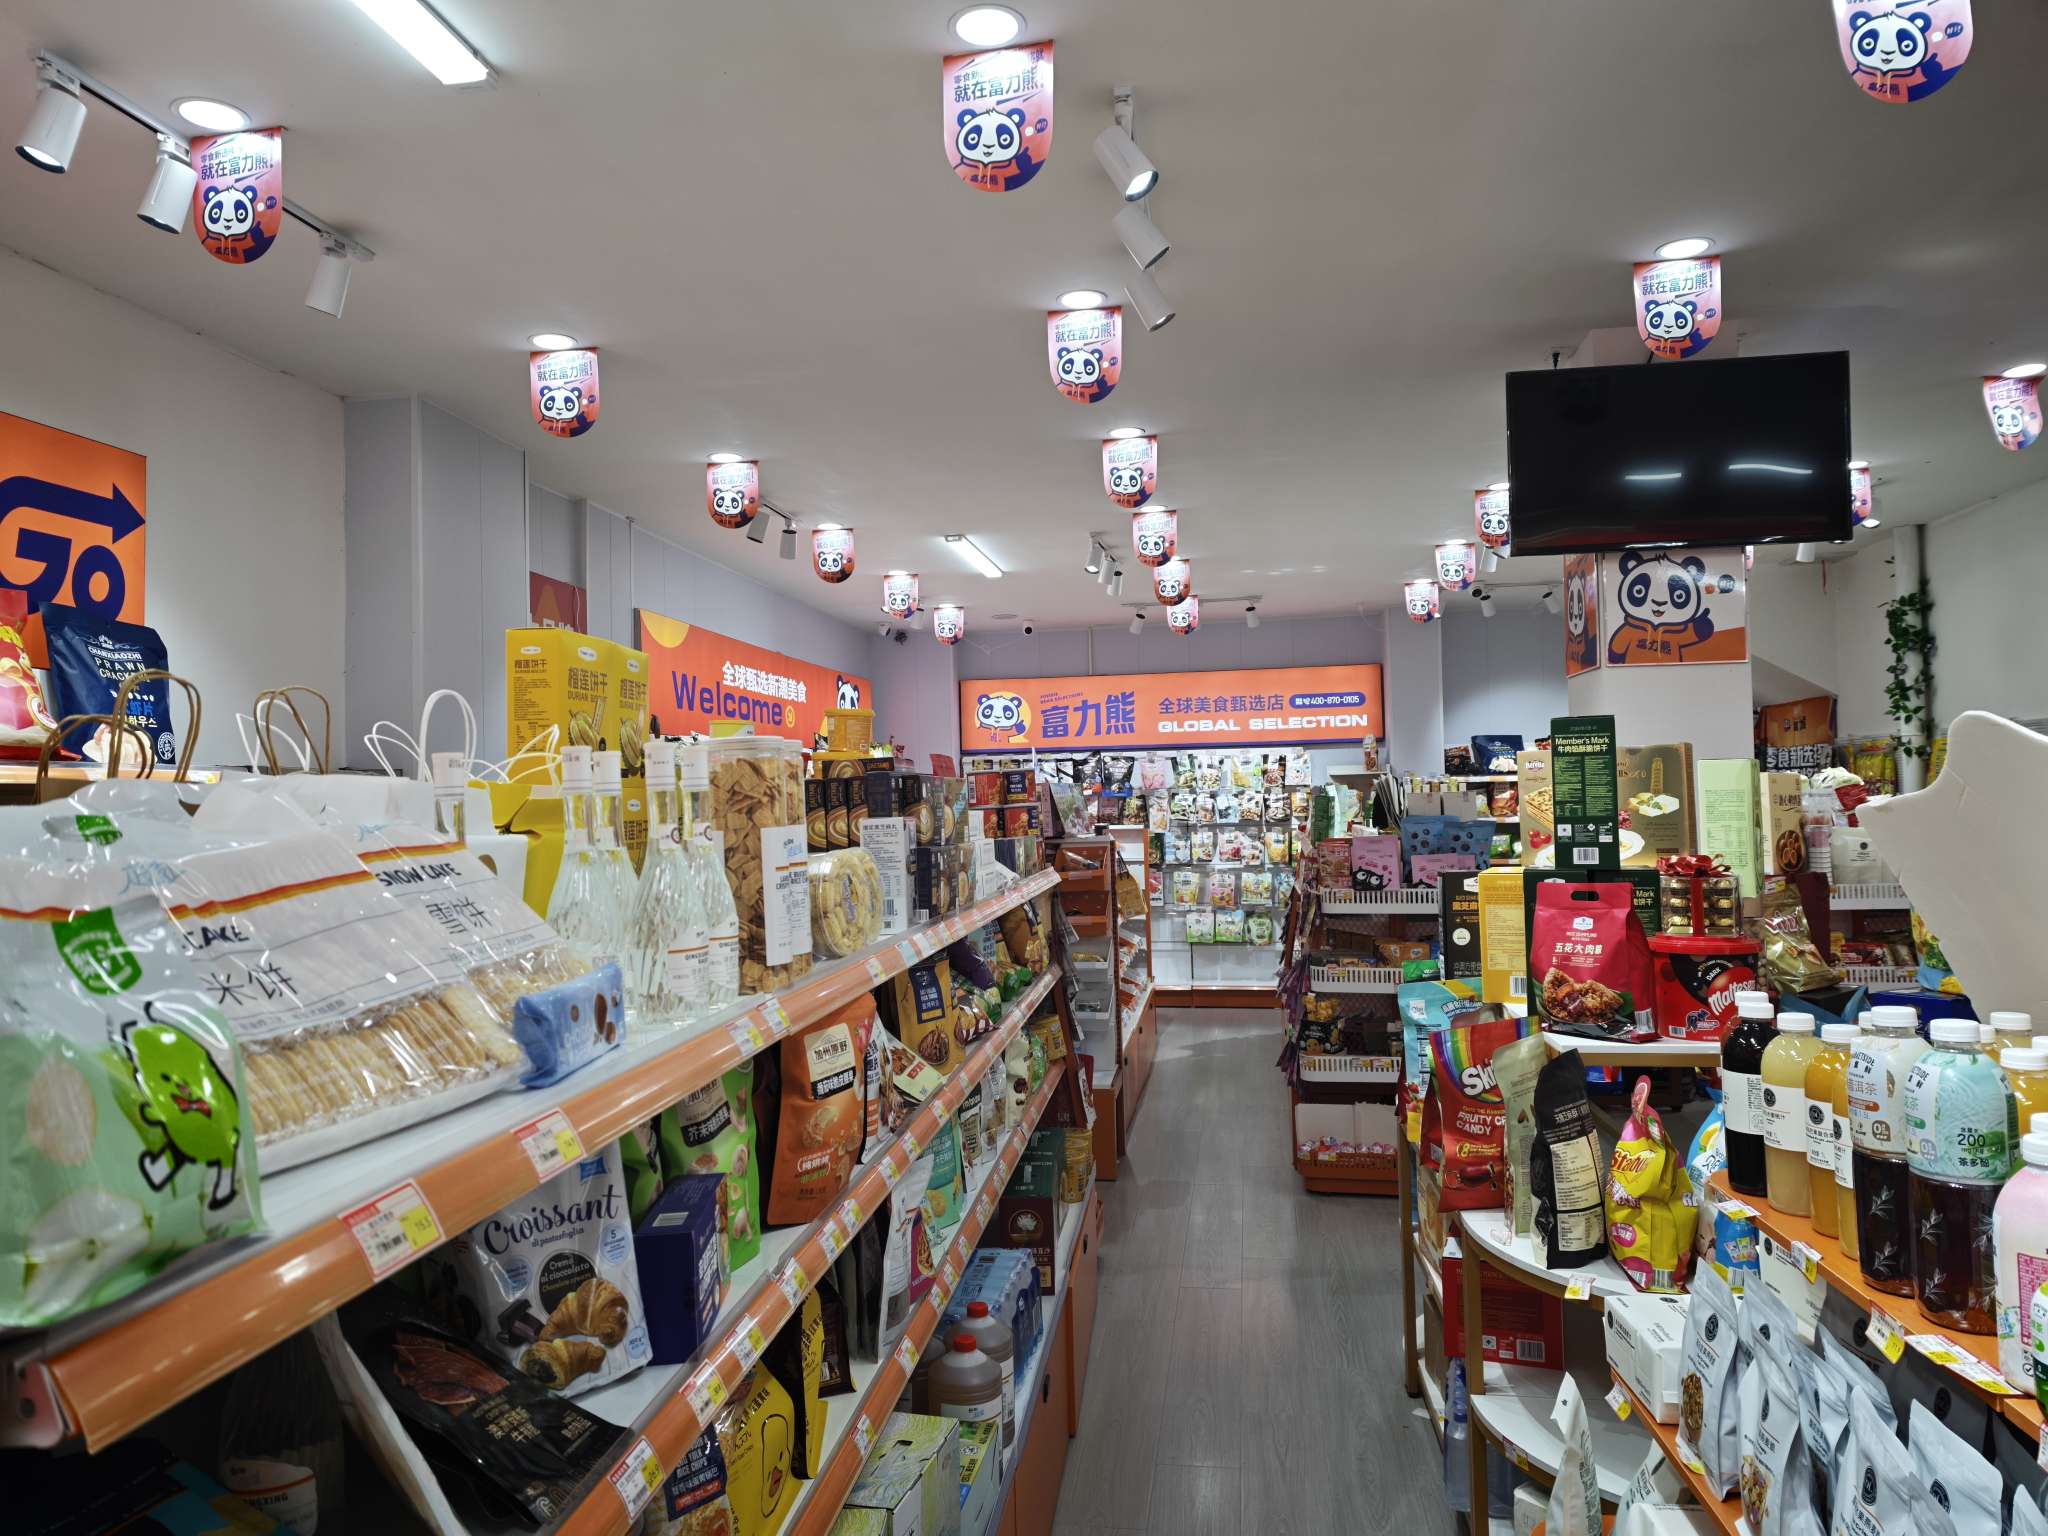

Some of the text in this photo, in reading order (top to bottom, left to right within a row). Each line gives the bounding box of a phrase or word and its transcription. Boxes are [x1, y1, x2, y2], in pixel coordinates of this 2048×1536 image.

[95, 656, 146, 671] PRAWN
[721, 660, 807, 704] 全球甄选新潮美食
[671, 670, 783, 726] Welcome
[1159, 694, 1284, 715] 全球美食甄选店
[1041, 690, 1135, 738] 富力熊
[1158, 714, 1368, 733] GLOBAL SELECTION
[1555, 735, 1610, 745] Member's Mark
[375, 860, 462, 888] SNOW CAKE
[425, 897, 491, 935] 雪饼
[1705, 966, 1722, 982] DARK
[1456, 1119, 1492, 1136] CANDY
[1457, 1111, 1492, 1125] FRUITY
[1956, 1132, 1986, 1148] 200
[483, 1183, 623, 1255] Croissant
[610, 1229, 617, 1239] 5
